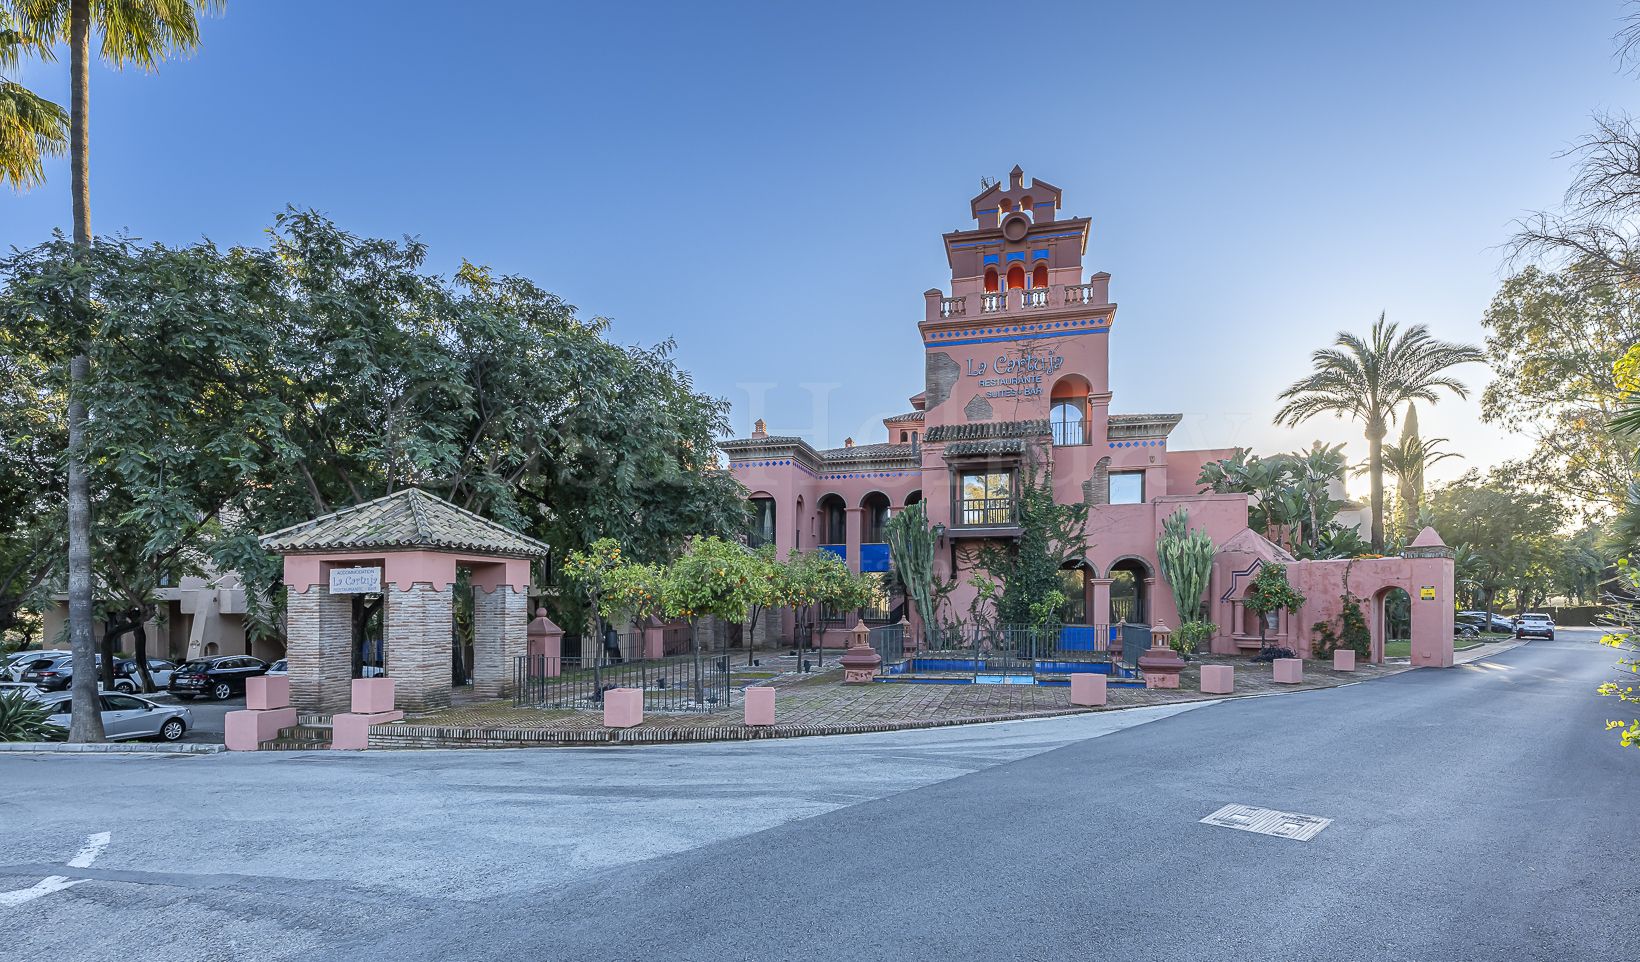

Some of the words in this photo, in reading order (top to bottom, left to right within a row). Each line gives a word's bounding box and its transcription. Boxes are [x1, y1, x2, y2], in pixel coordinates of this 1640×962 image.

[967, 358, 987, 376] La
[993, 350, 1064, 375] Cartuja
[978, 376, 1042, 387] RESTAURANTE
[986, 389, 1017, 399] SUITES
[1024, 387, 1043, 396] BAR
